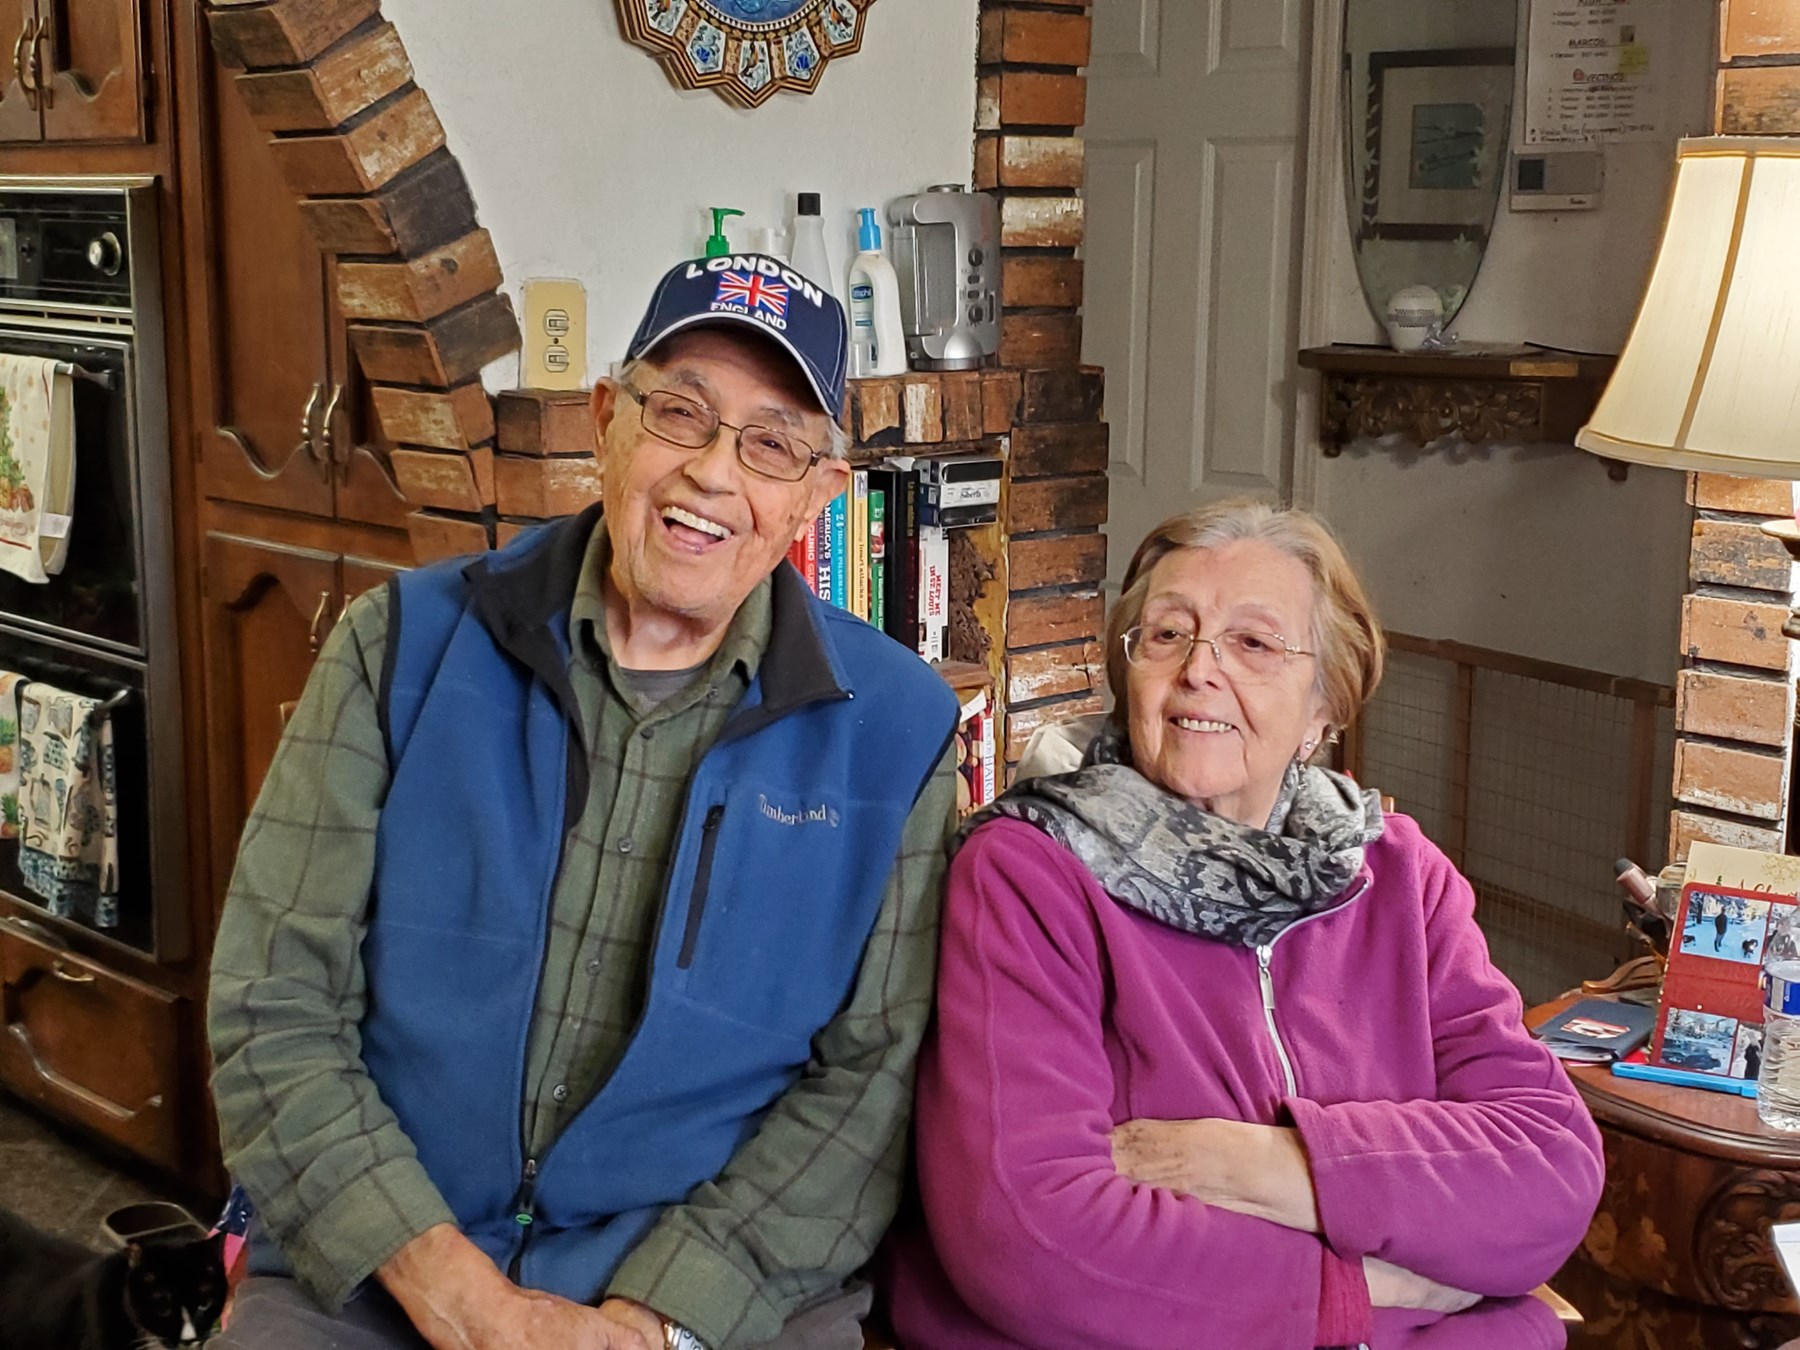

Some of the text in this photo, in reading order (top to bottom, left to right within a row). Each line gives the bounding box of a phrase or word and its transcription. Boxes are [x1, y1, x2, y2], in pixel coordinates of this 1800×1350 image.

[1568, 38, 1606, 48] MARCOS
[686, 255, 823, 308] LONDON
[818, 566, 830, 601] HIS
[929, 565, 936, 576] IN
[935, 602, 942, 616] ME
[984, 755, 994, 802] HARM
[758, 793, 826, 826] Timberland
